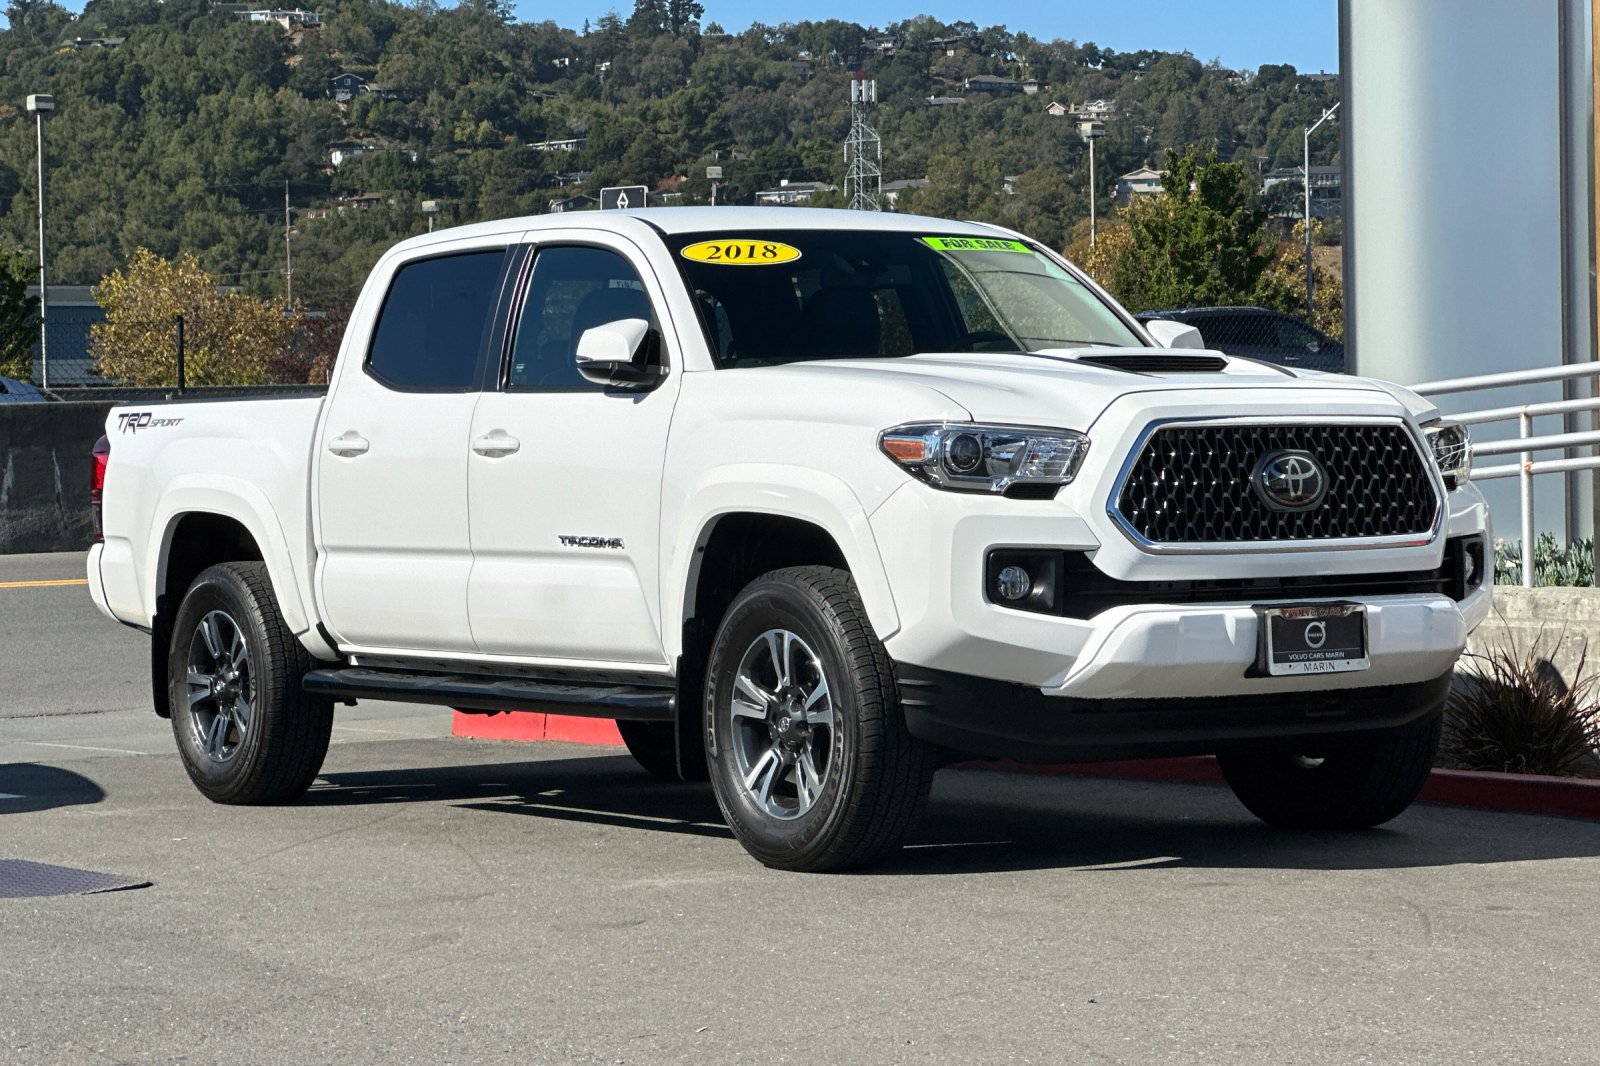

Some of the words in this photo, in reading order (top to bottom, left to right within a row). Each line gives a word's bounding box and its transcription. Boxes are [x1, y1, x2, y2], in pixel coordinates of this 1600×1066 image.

[940, 239, 972, 249] FOR
[975, 240, 1013, 250] SALE
[706, 244, 777, 260] 2018
[118, 412, 152, 435] TRD
[149, 418, 184, 427] SPORT
[558, 535, 625, 549] TACOMA
[1303, 661, 1336, 671] MARIN
